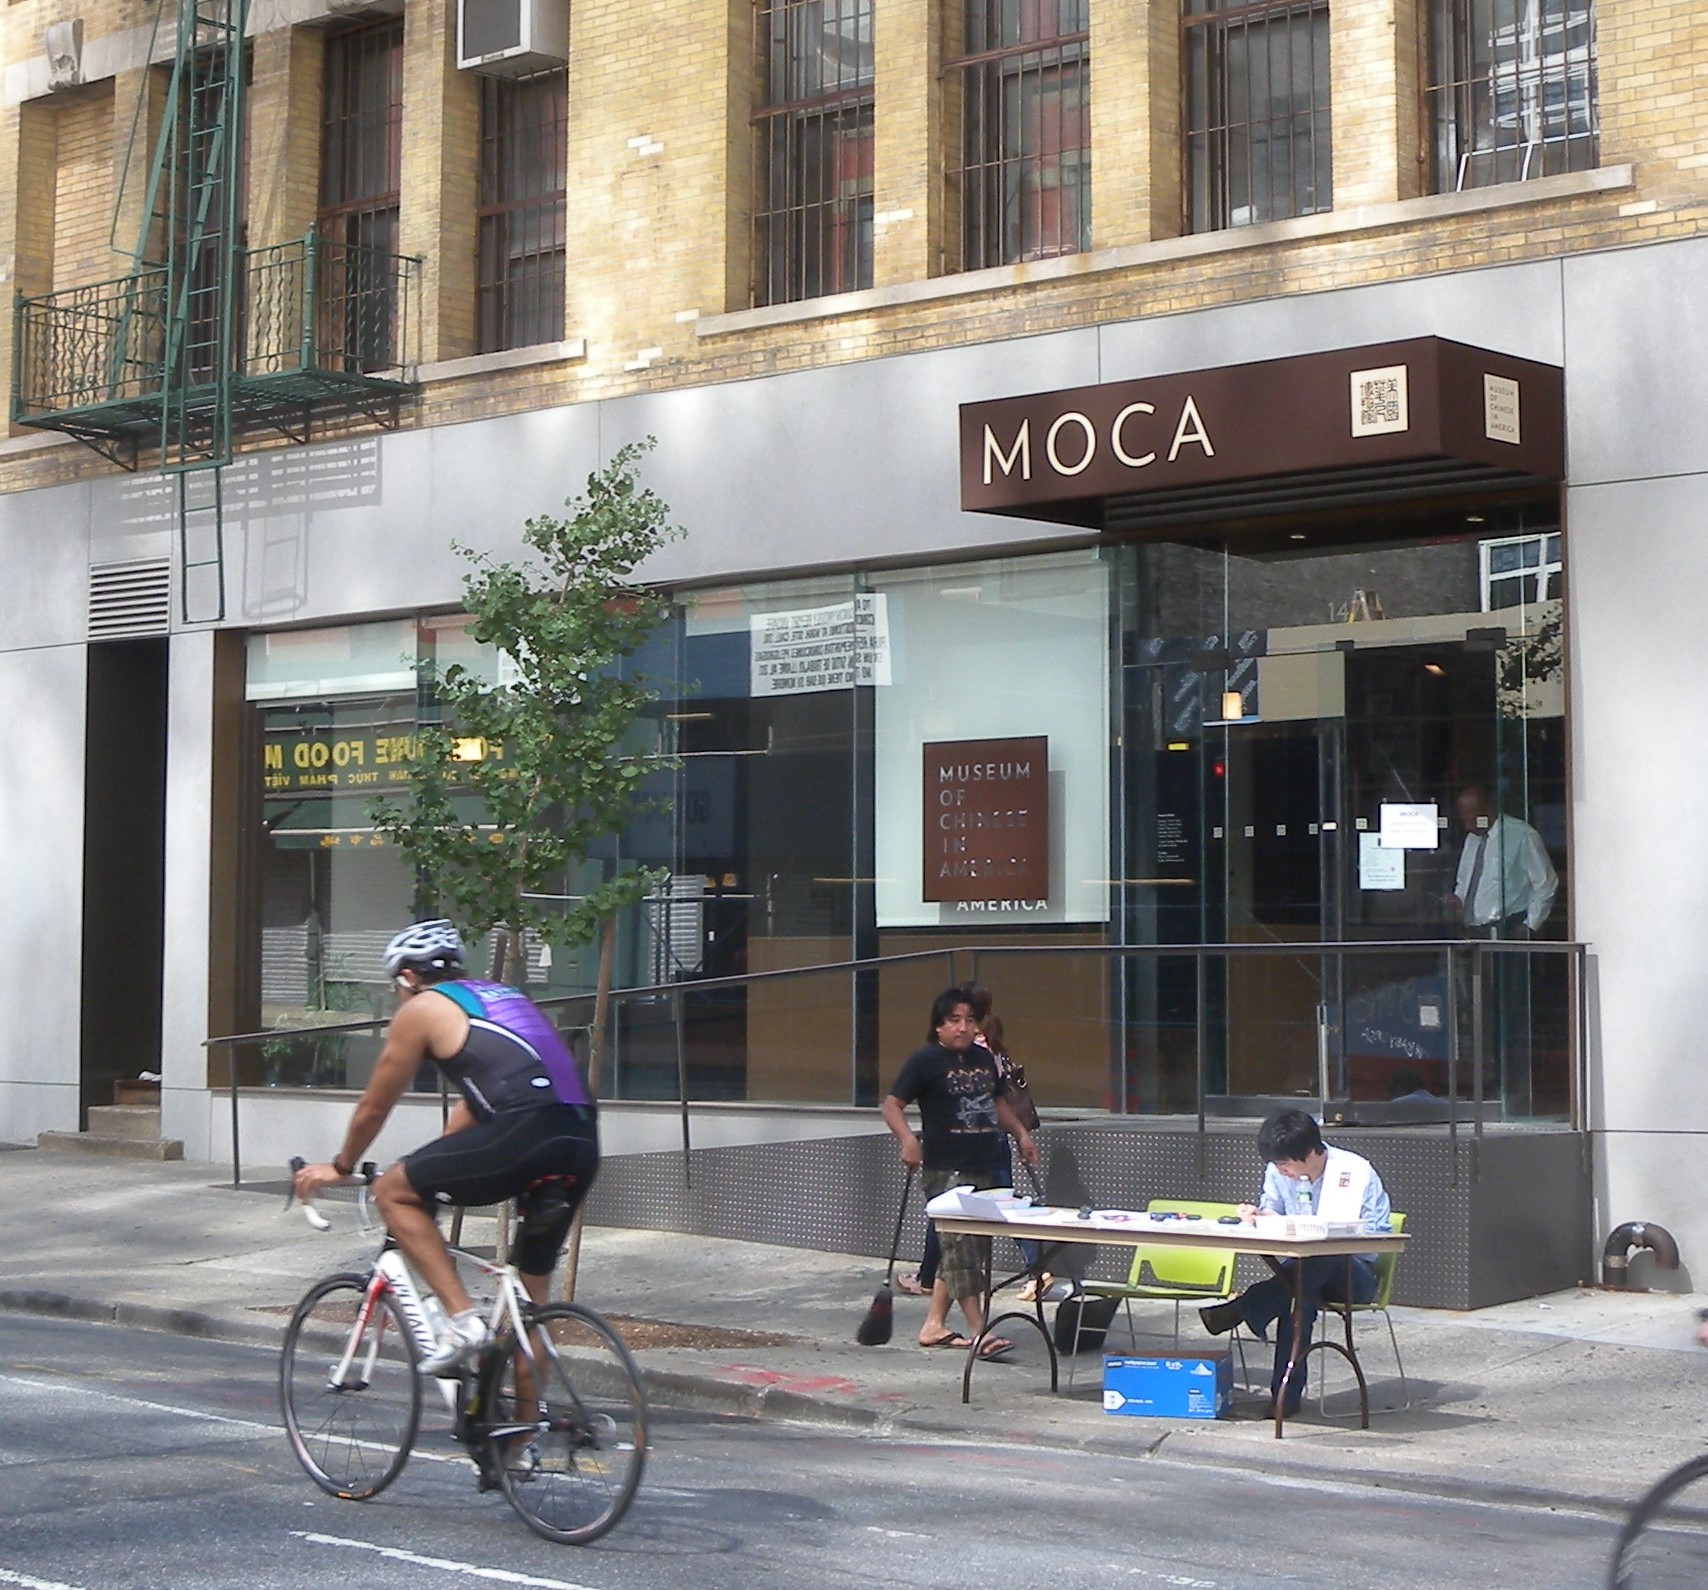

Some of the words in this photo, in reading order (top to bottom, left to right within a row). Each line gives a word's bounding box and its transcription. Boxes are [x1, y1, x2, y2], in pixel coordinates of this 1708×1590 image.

[983, 395, 1215, 485] MOCA
[940, 762, 1030, 783] MUSEUM
[940, 789, 966, 806] OF
